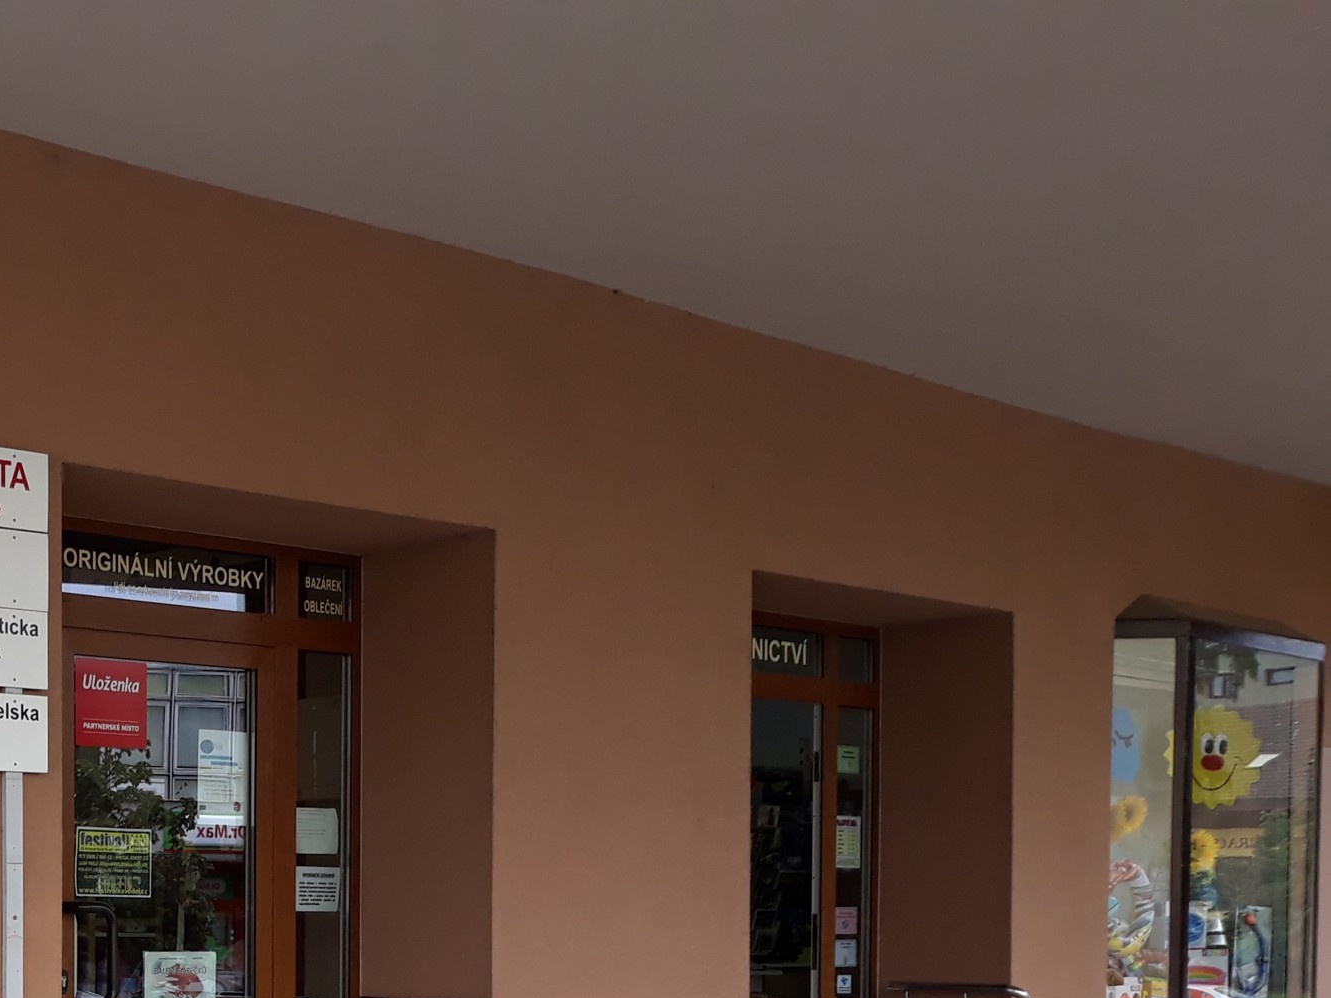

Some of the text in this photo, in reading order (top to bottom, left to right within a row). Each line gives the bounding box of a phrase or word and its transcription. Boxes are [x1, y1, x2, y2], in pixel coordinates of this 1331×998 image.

[63, 547, 264, 591] ORIGINÁLNÍ VÝROBKY
[305, 575, 343, 593] BAZÁREK
[303, 599, 343, 616] OBLEČENÍ
[82, 673, 140, 693] Uloženka
[82, 722, 140, 732] PARTNERSKÉ MÍSTO
